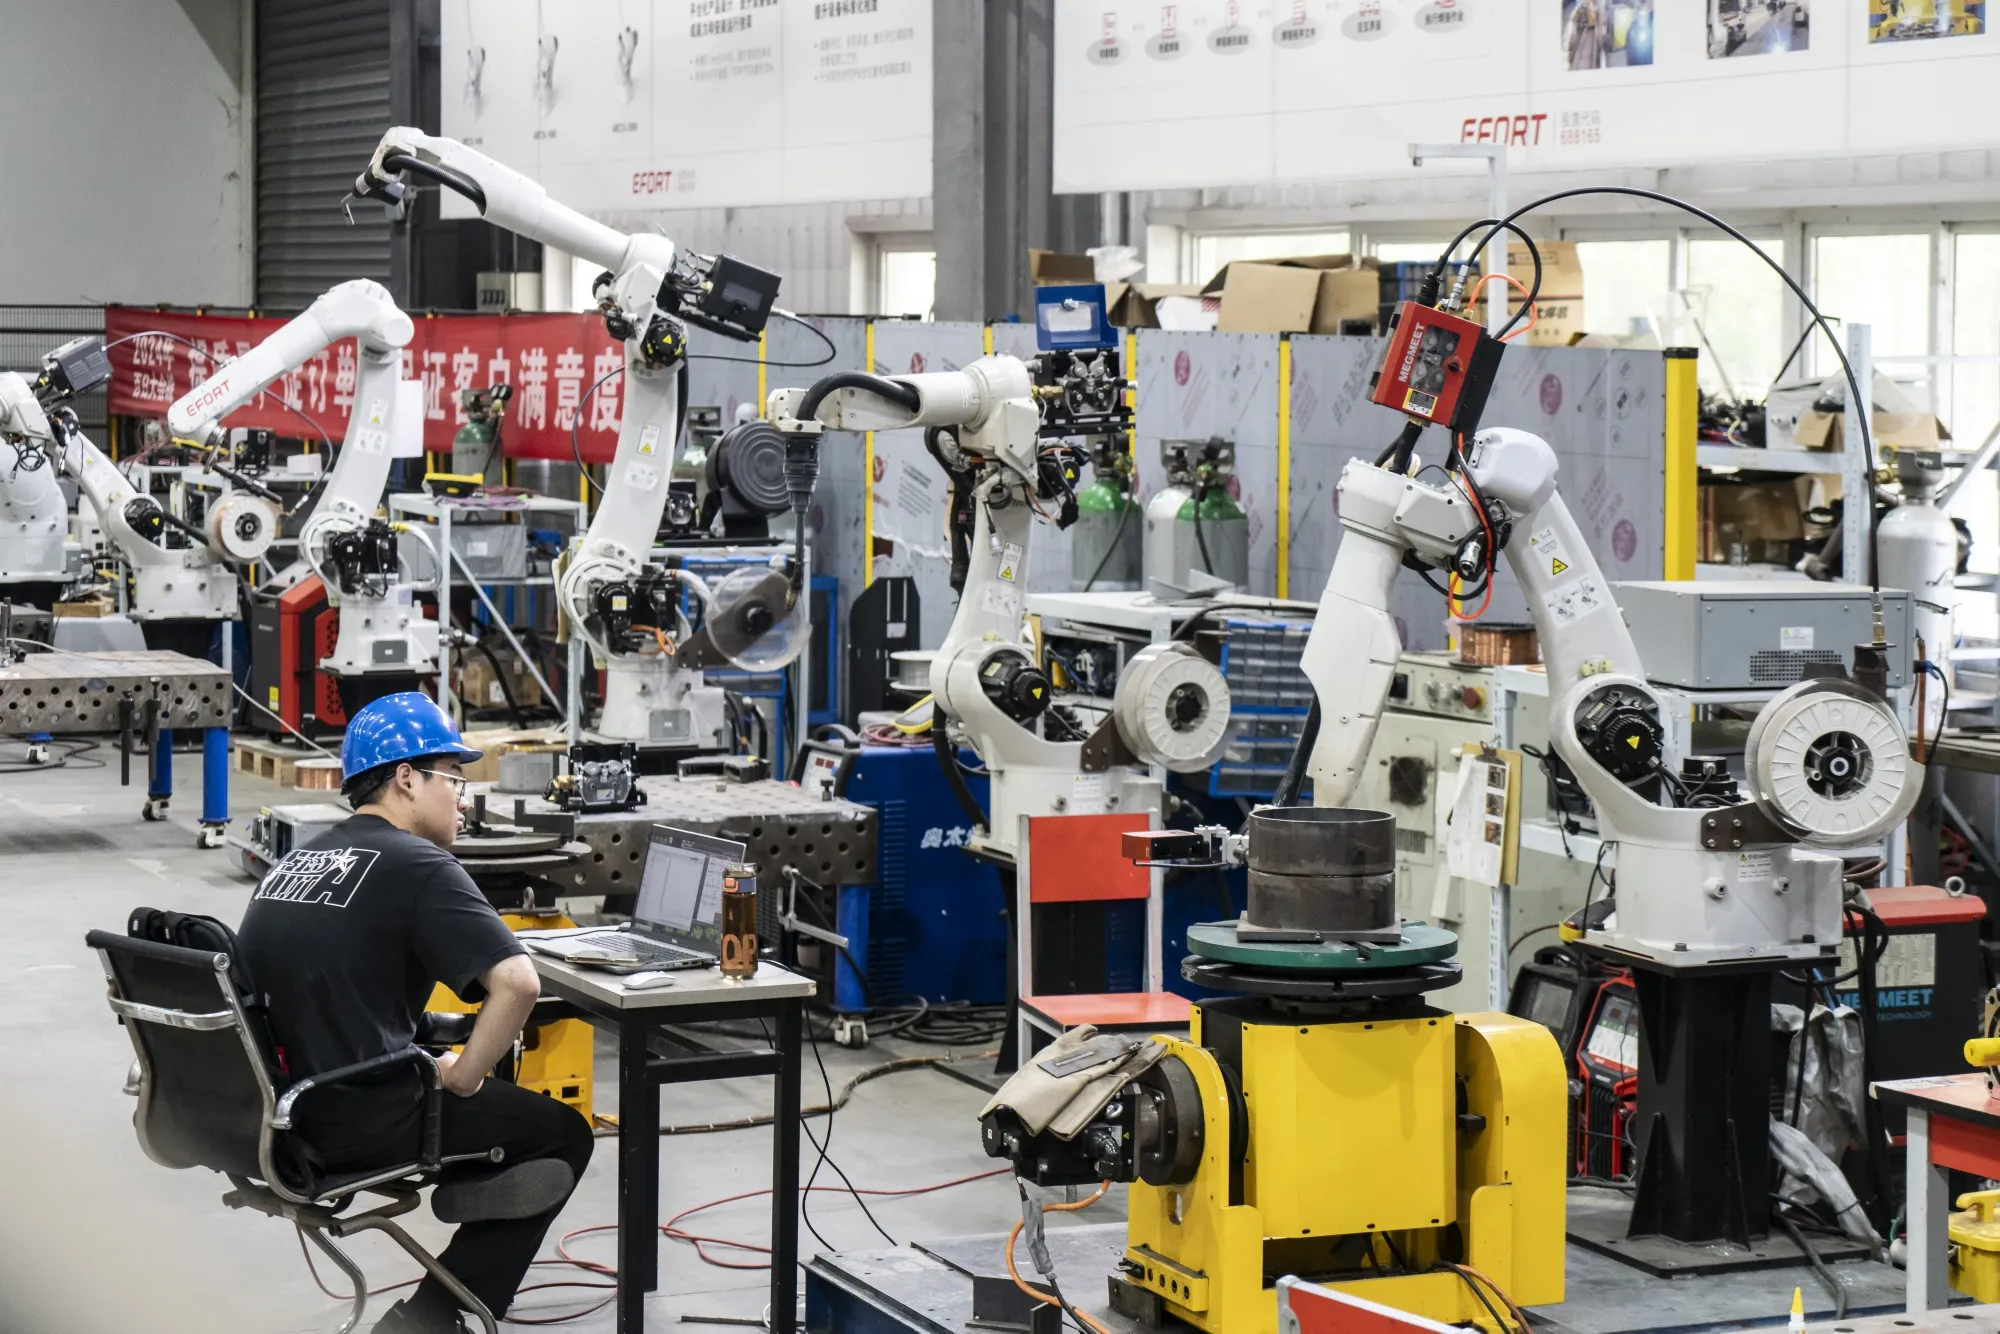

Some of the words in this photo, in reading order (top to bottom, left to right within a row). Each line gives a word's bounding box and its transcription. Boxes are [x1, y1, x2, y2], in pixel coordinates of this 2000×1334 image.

[1461, 114, 1547, 146] EFORT
[632, 170, 672, 195] EFORT
[1398, 321, 1425, 383] MEGMEET
[186, 379, 231, 418] EFORT
